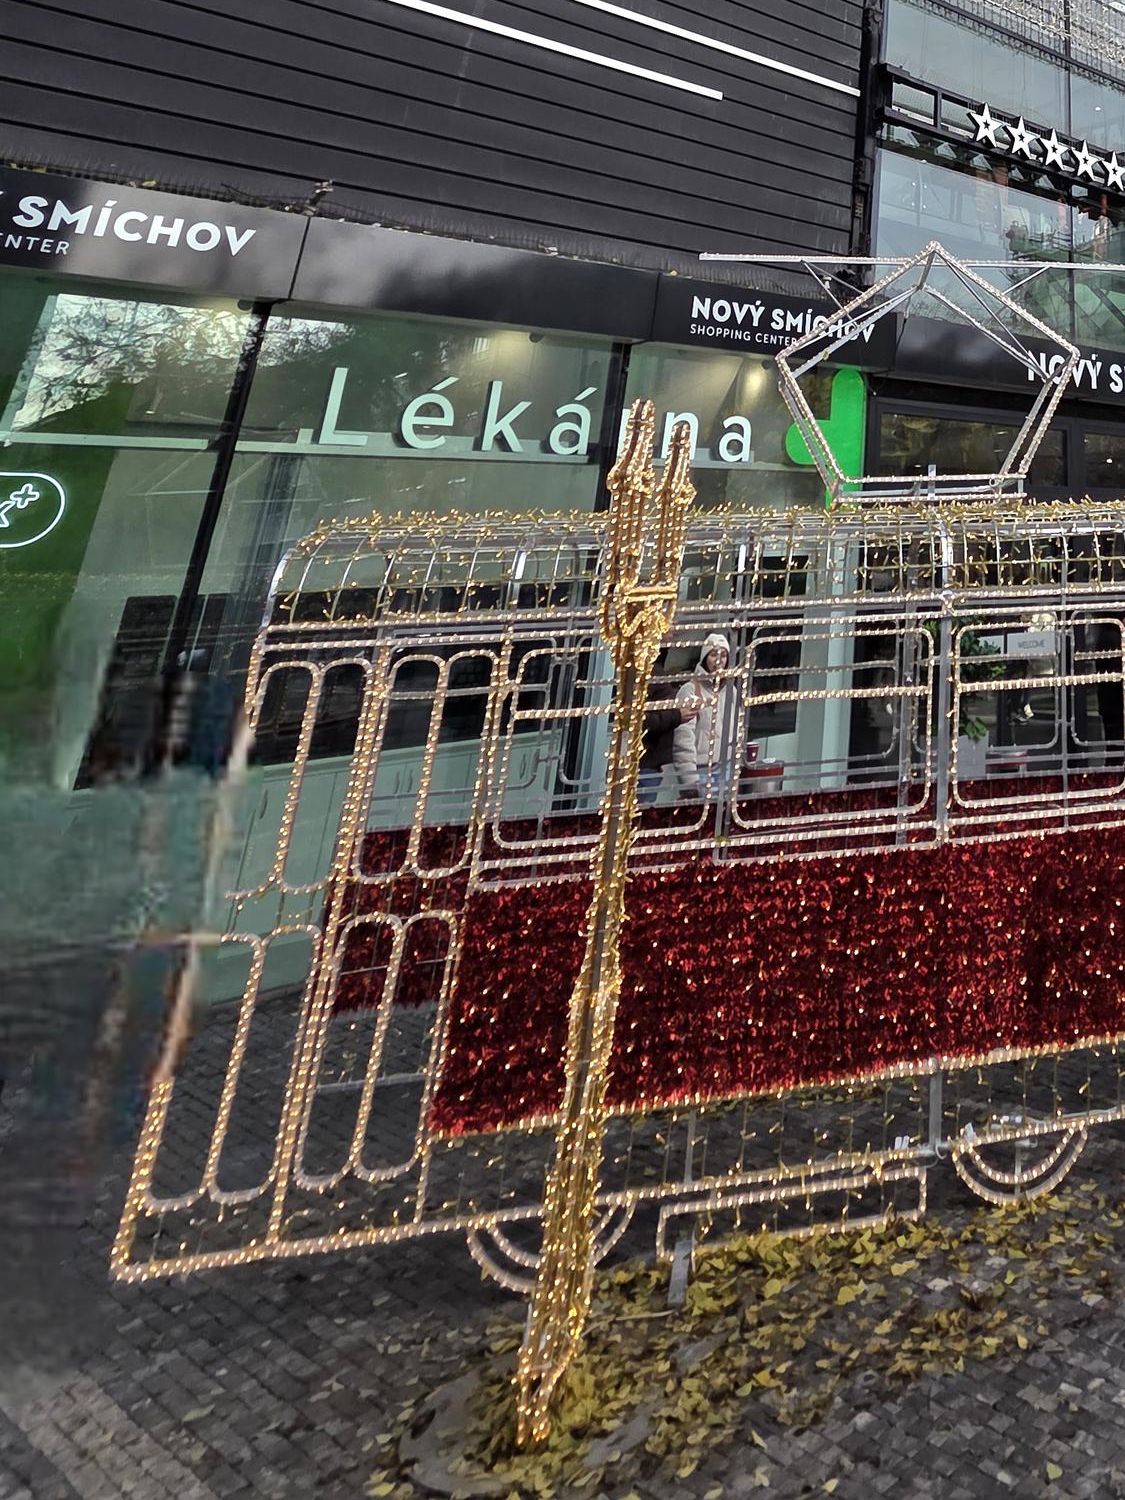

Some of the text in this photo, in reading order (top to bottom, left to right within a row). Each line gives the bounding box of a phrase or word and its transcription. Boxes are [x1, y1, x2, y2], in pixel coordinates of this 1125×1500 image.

[12, 195, 257, 256] SMÍCHOV
[0, 232, 70, 255] NTER
[691, 295, 765, 327] NOVÝ
[690, 323, 798, 347] SHOPPING CENTER
[1028, 350, 1102, 390] NOVÝ
